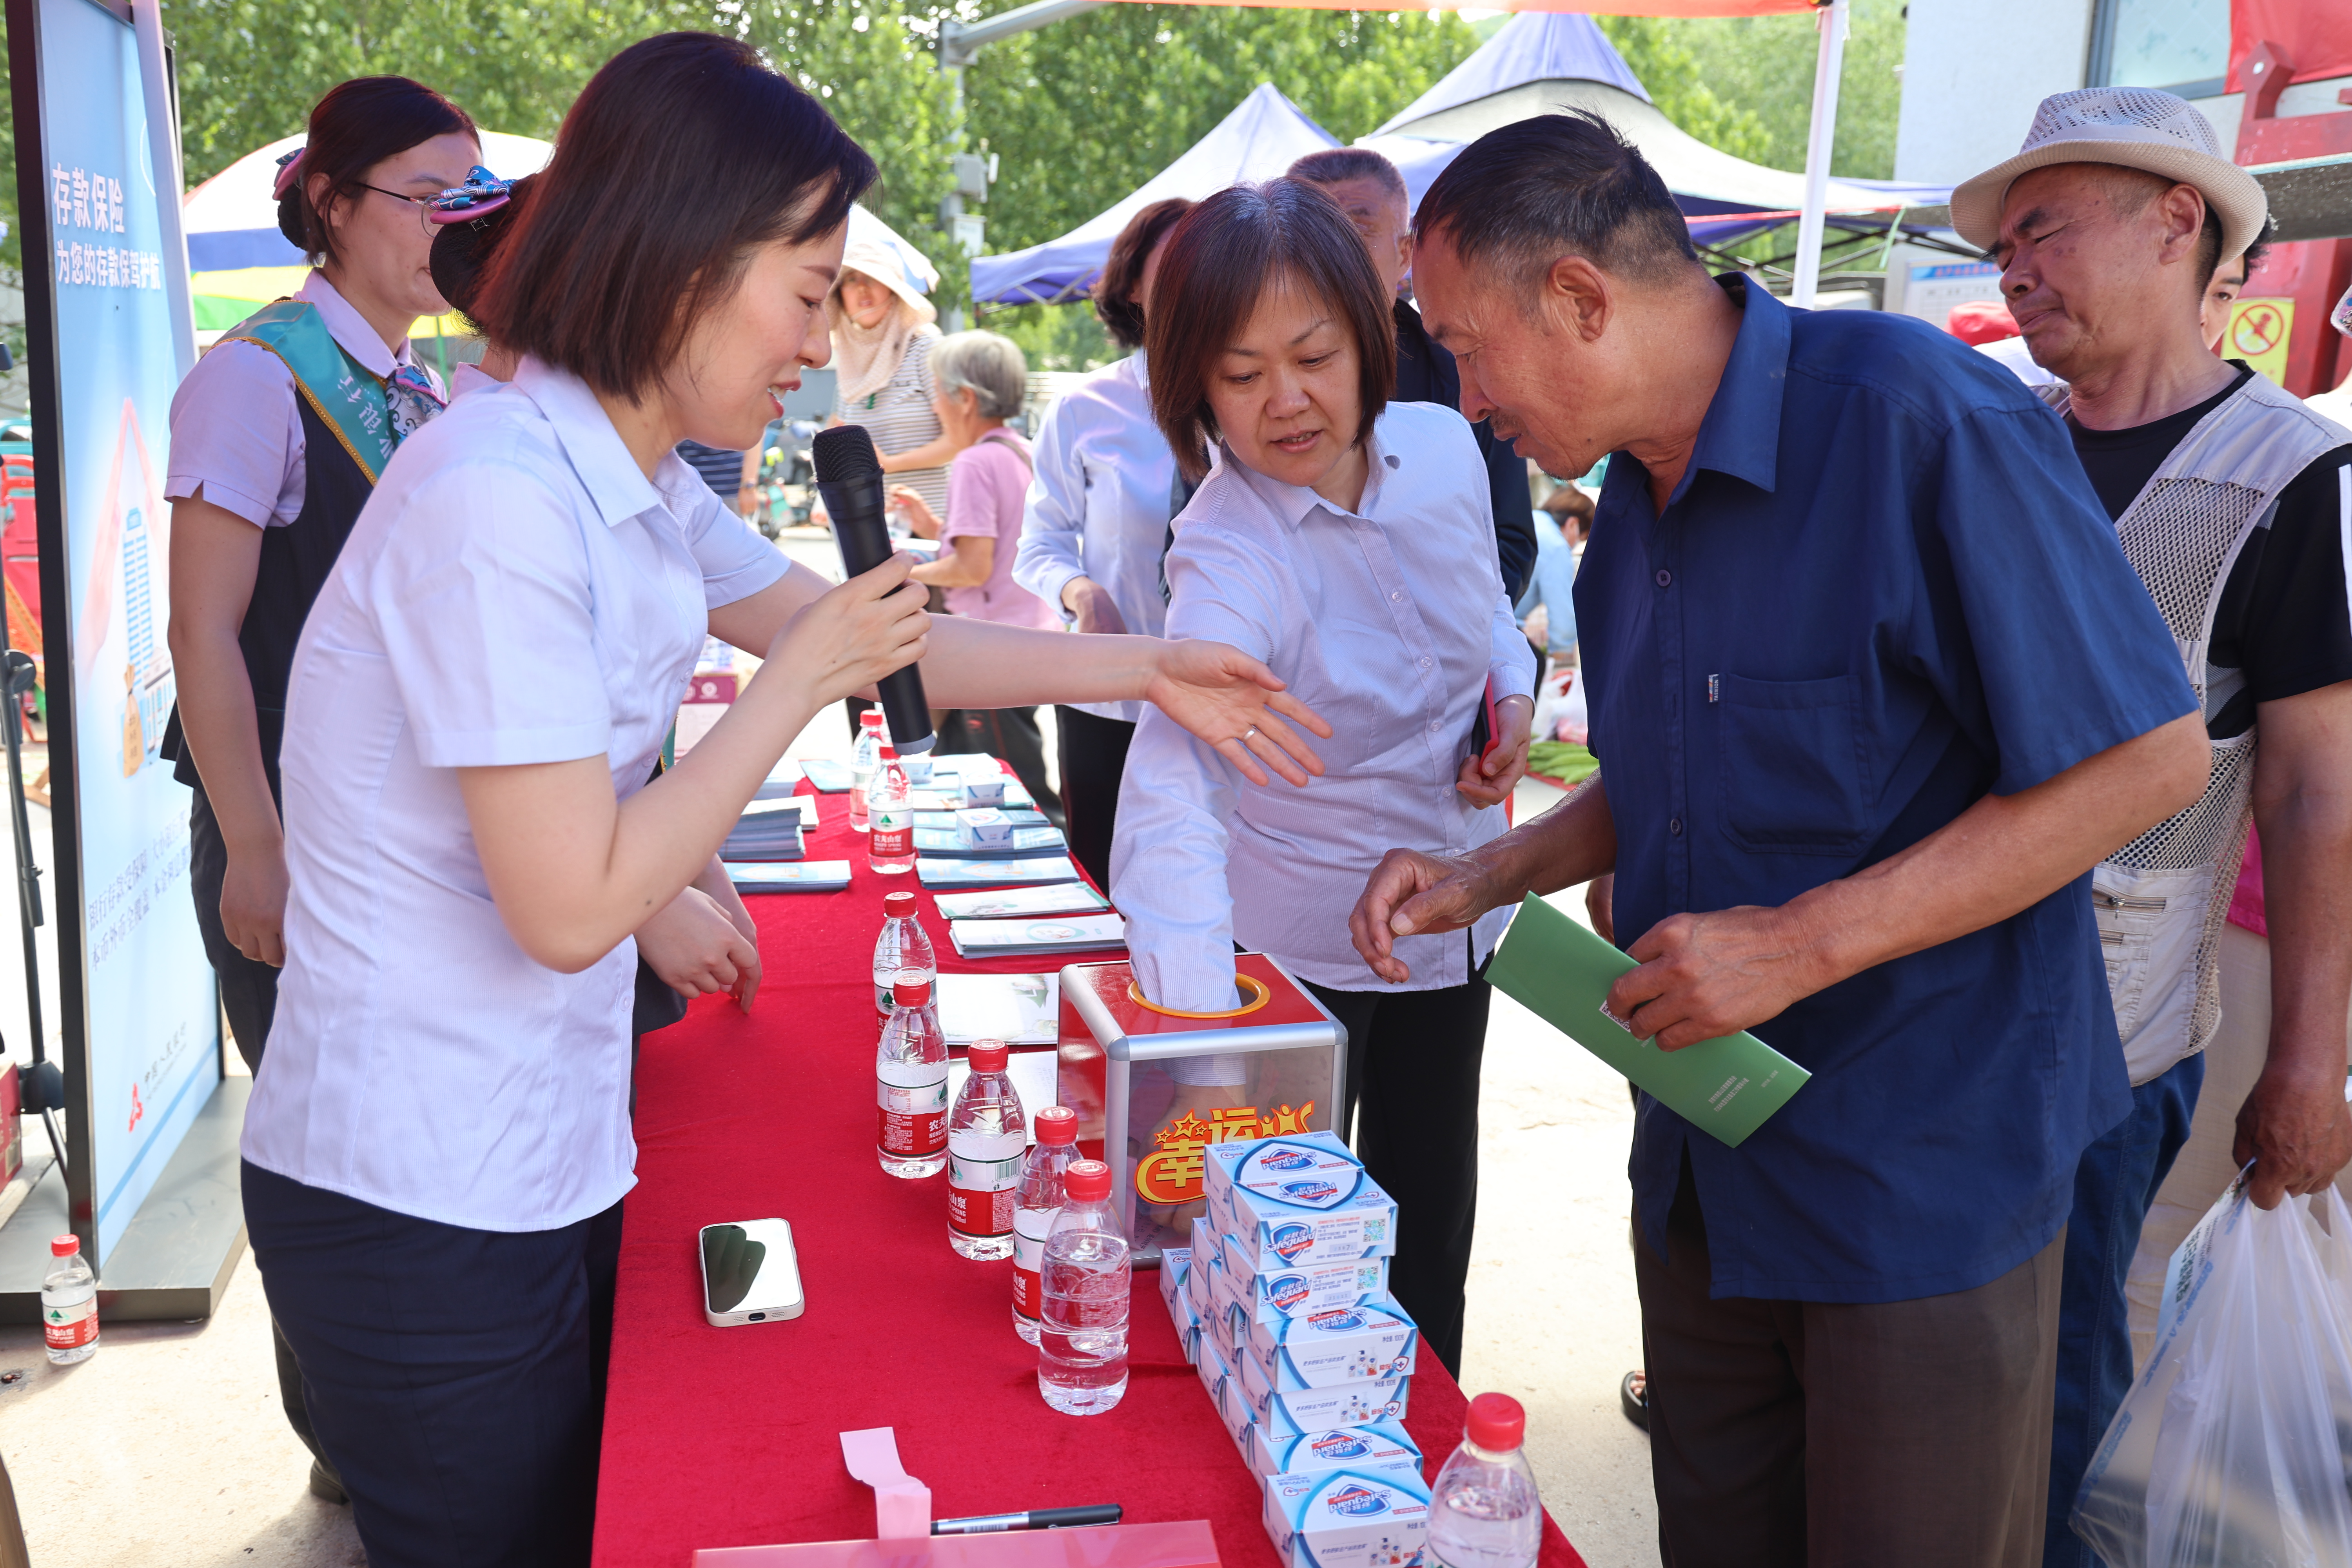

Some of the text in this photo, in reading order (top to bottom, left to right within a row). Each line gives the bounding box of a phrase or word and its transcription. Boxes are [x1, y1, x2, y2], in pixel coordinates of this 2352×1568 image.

[53, 162, 125, 233] 存款保险
[57, 239, 161, 290] 为您的存款保驾护航
[929, 1130, 946, 1138] NONGFU
[1261, 1151, 1316, 1170] Safeguard
[1279, 1183, 1336, 1200] Safeguard
[952, 1205, 966, 1217] SPRING
[1263, 1229, 1317, 1254] Safeguard
[1283, 1229, 1307, 1241] 舒肤佳
[1260, 1279, 1312, 1307] Safeguard
[1279, 1280, 1303, 1294] 舒肤佳
[1309, 1309, 1367, 1330] Safeguard
[1312, 1435, 1373, 1457] Safeguard
[1325, 1445, 1353, 1457] 舒肤佳
[1328, 1490, 1392, 1514] Safeguard
[1343, 1500, 1371, 1513] 舒肤佳
